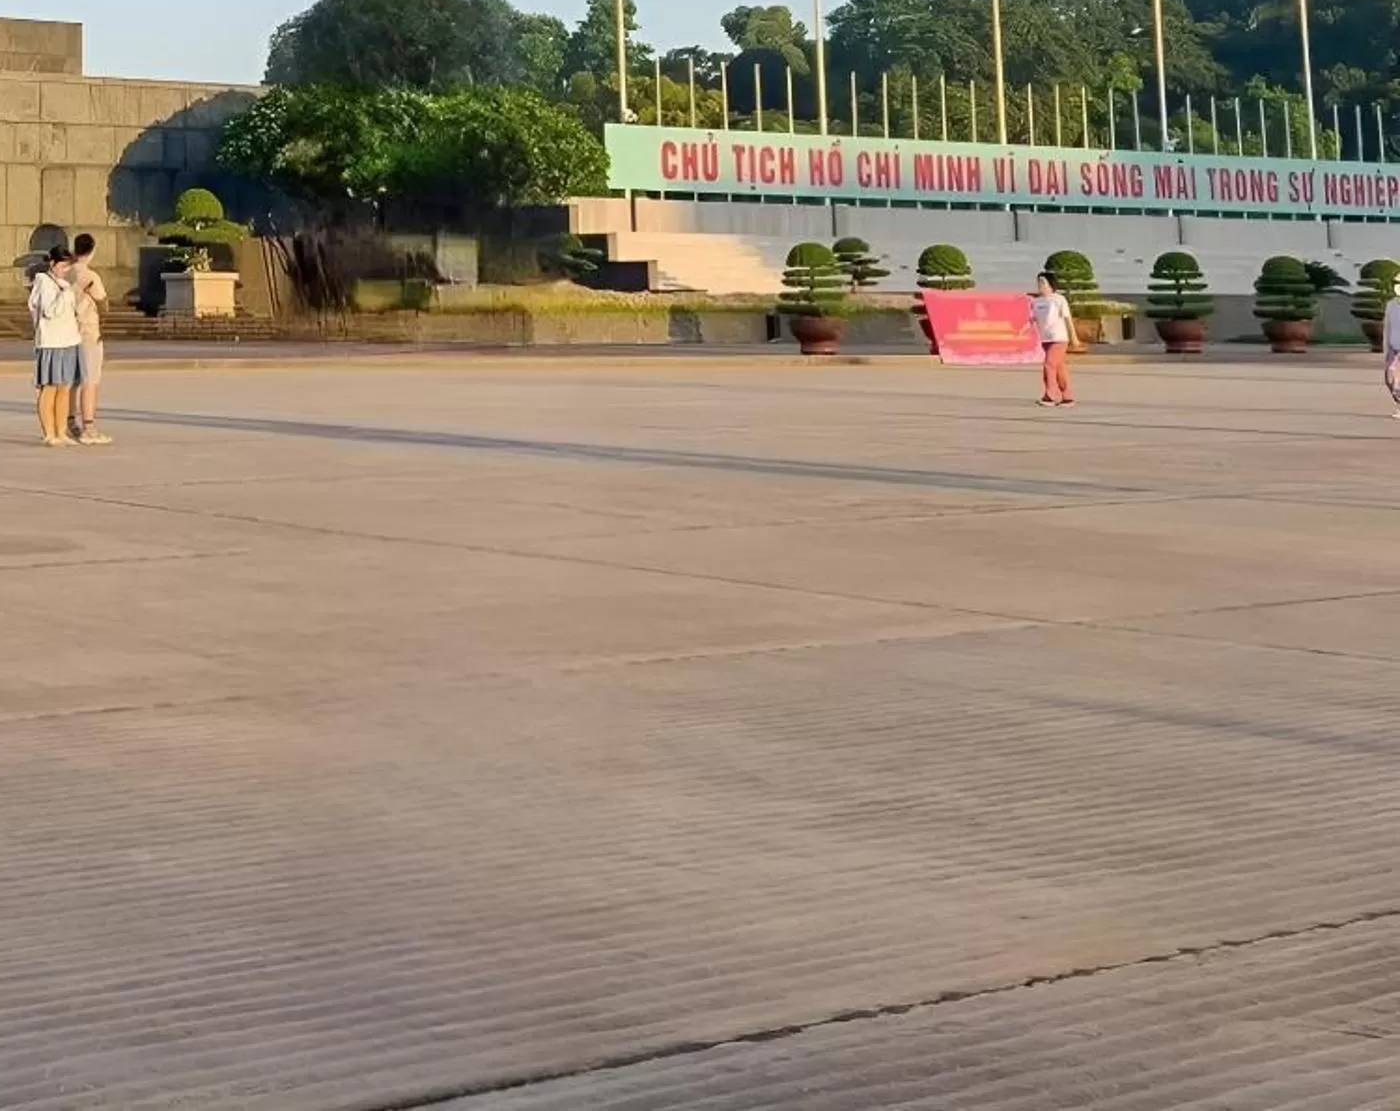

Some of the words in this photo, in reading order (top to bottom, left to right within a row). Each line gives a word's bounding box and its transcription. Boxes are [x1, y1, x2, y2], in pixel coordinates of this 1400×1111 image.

[661, 132, 719, 182] CHỦ
[731, 144, 795, 190] TỊCH
[857, 144, 900, 189] CHÍ
[914, 153, 981, 193] MINH
[1207, 167, 1279, 203] TRONG
[1288, 168, 1315, 212] SỰ
